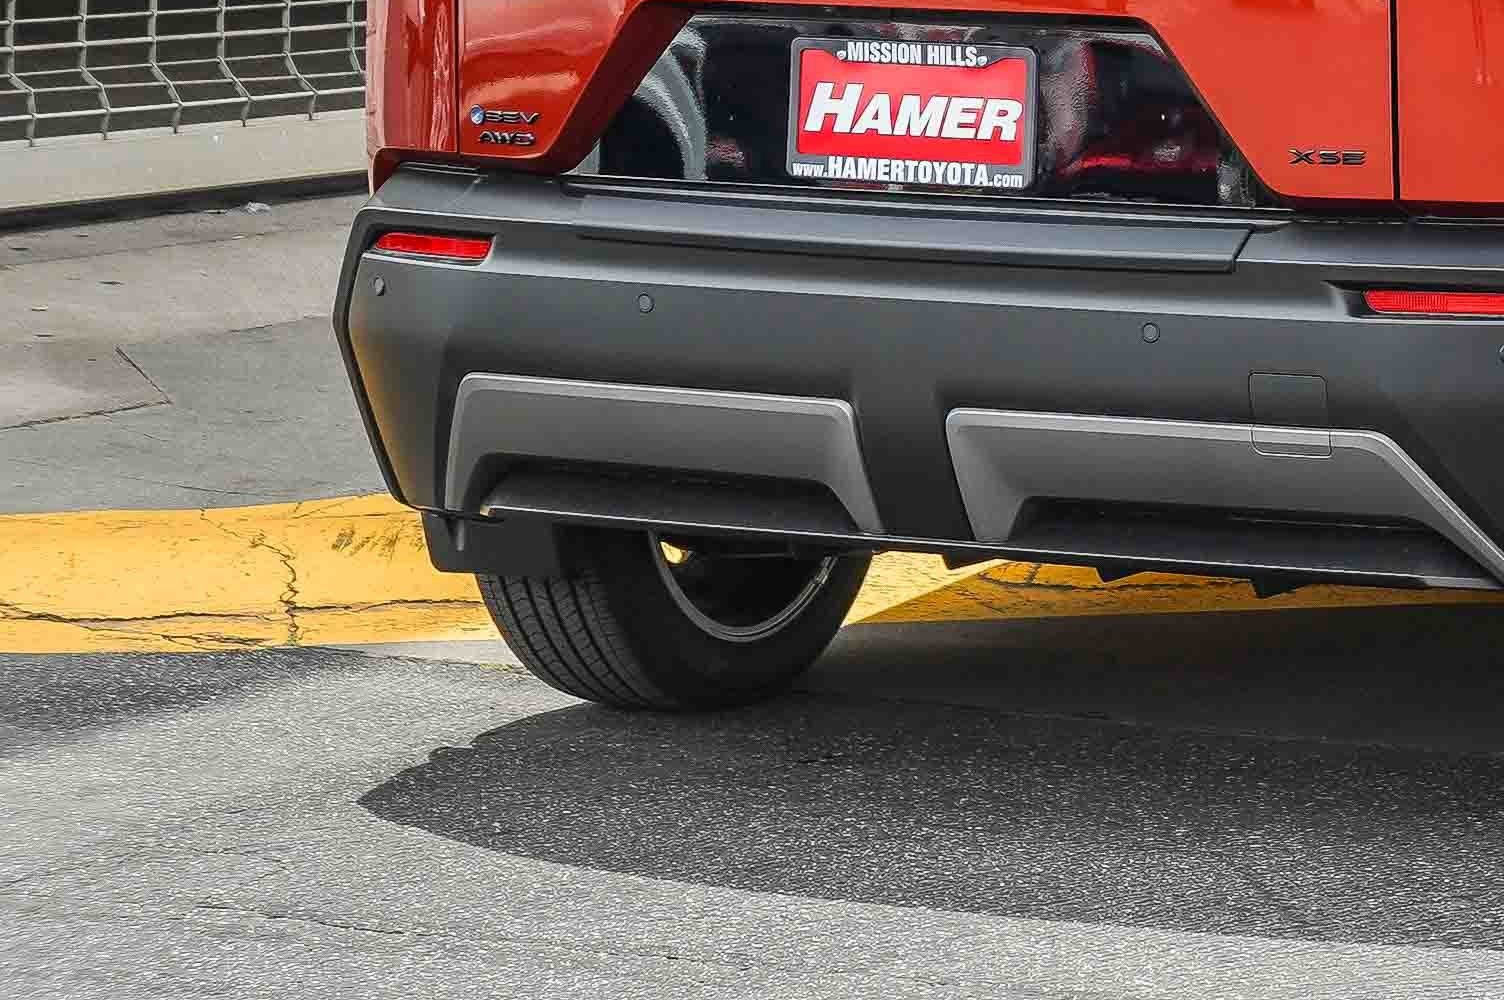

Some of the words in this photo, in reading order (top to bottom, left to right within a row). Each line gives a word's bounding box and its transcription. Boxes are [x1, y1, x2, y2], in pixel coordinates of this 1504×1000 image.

[847, 41, 922, 65] MISSION
[927, 44, 978, 67] HILLS
[803, 81, 1023, 141] HAMER
[479, 131, 535, 146] AWD
[1287, 148, 1367, 165] XSE
[792, 156, 1024, 188] www.HAMERTOYOTA.com
